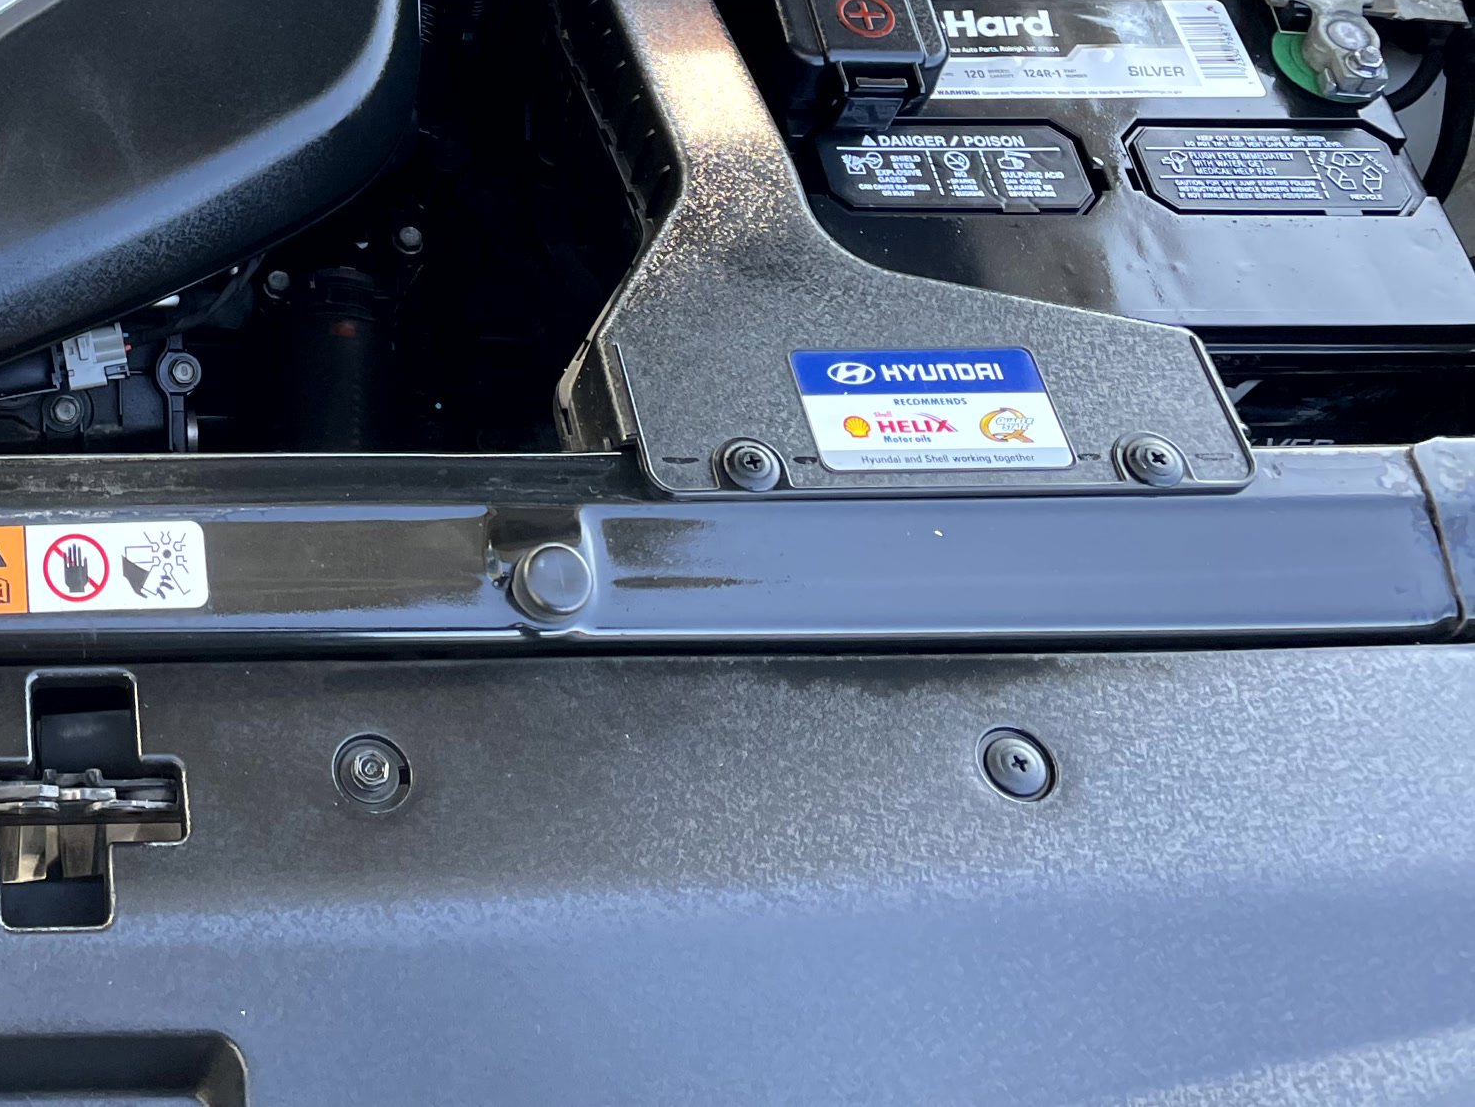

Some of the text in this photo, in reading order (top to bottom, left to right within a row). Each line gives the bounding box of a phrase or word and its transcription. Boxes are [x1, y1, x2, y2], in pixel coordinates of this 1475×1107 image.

[940, 9, 1055, 37] Hard
[964, 69, 985, 79] 120
[1023, 69, 1062, 79] 124R-1
[1128, 65, 1186, 78] SILVER
[877, 135, 947, 147] DANGER
[962, 135, 1026, 147] POISON
[1189, 152, 1294, 160] FLUSH EYES IMMEDIATELY
[875, 169, 923, 177] EXPLOSIVE
[1000, 171, 1043, 179] SULFURIC
[1195, 167, 1277, 175] MEDICAL HELP FAST
[880, 362, 1005, 382] HYUNDAI
[893, 397, 968, 407] RECOMMENDS
[877, 419, 957, 434] HELIX
[883, 435, 932, 443] Motor oils
[861, 453, 1036, 466] Hyundai and Shell working together
